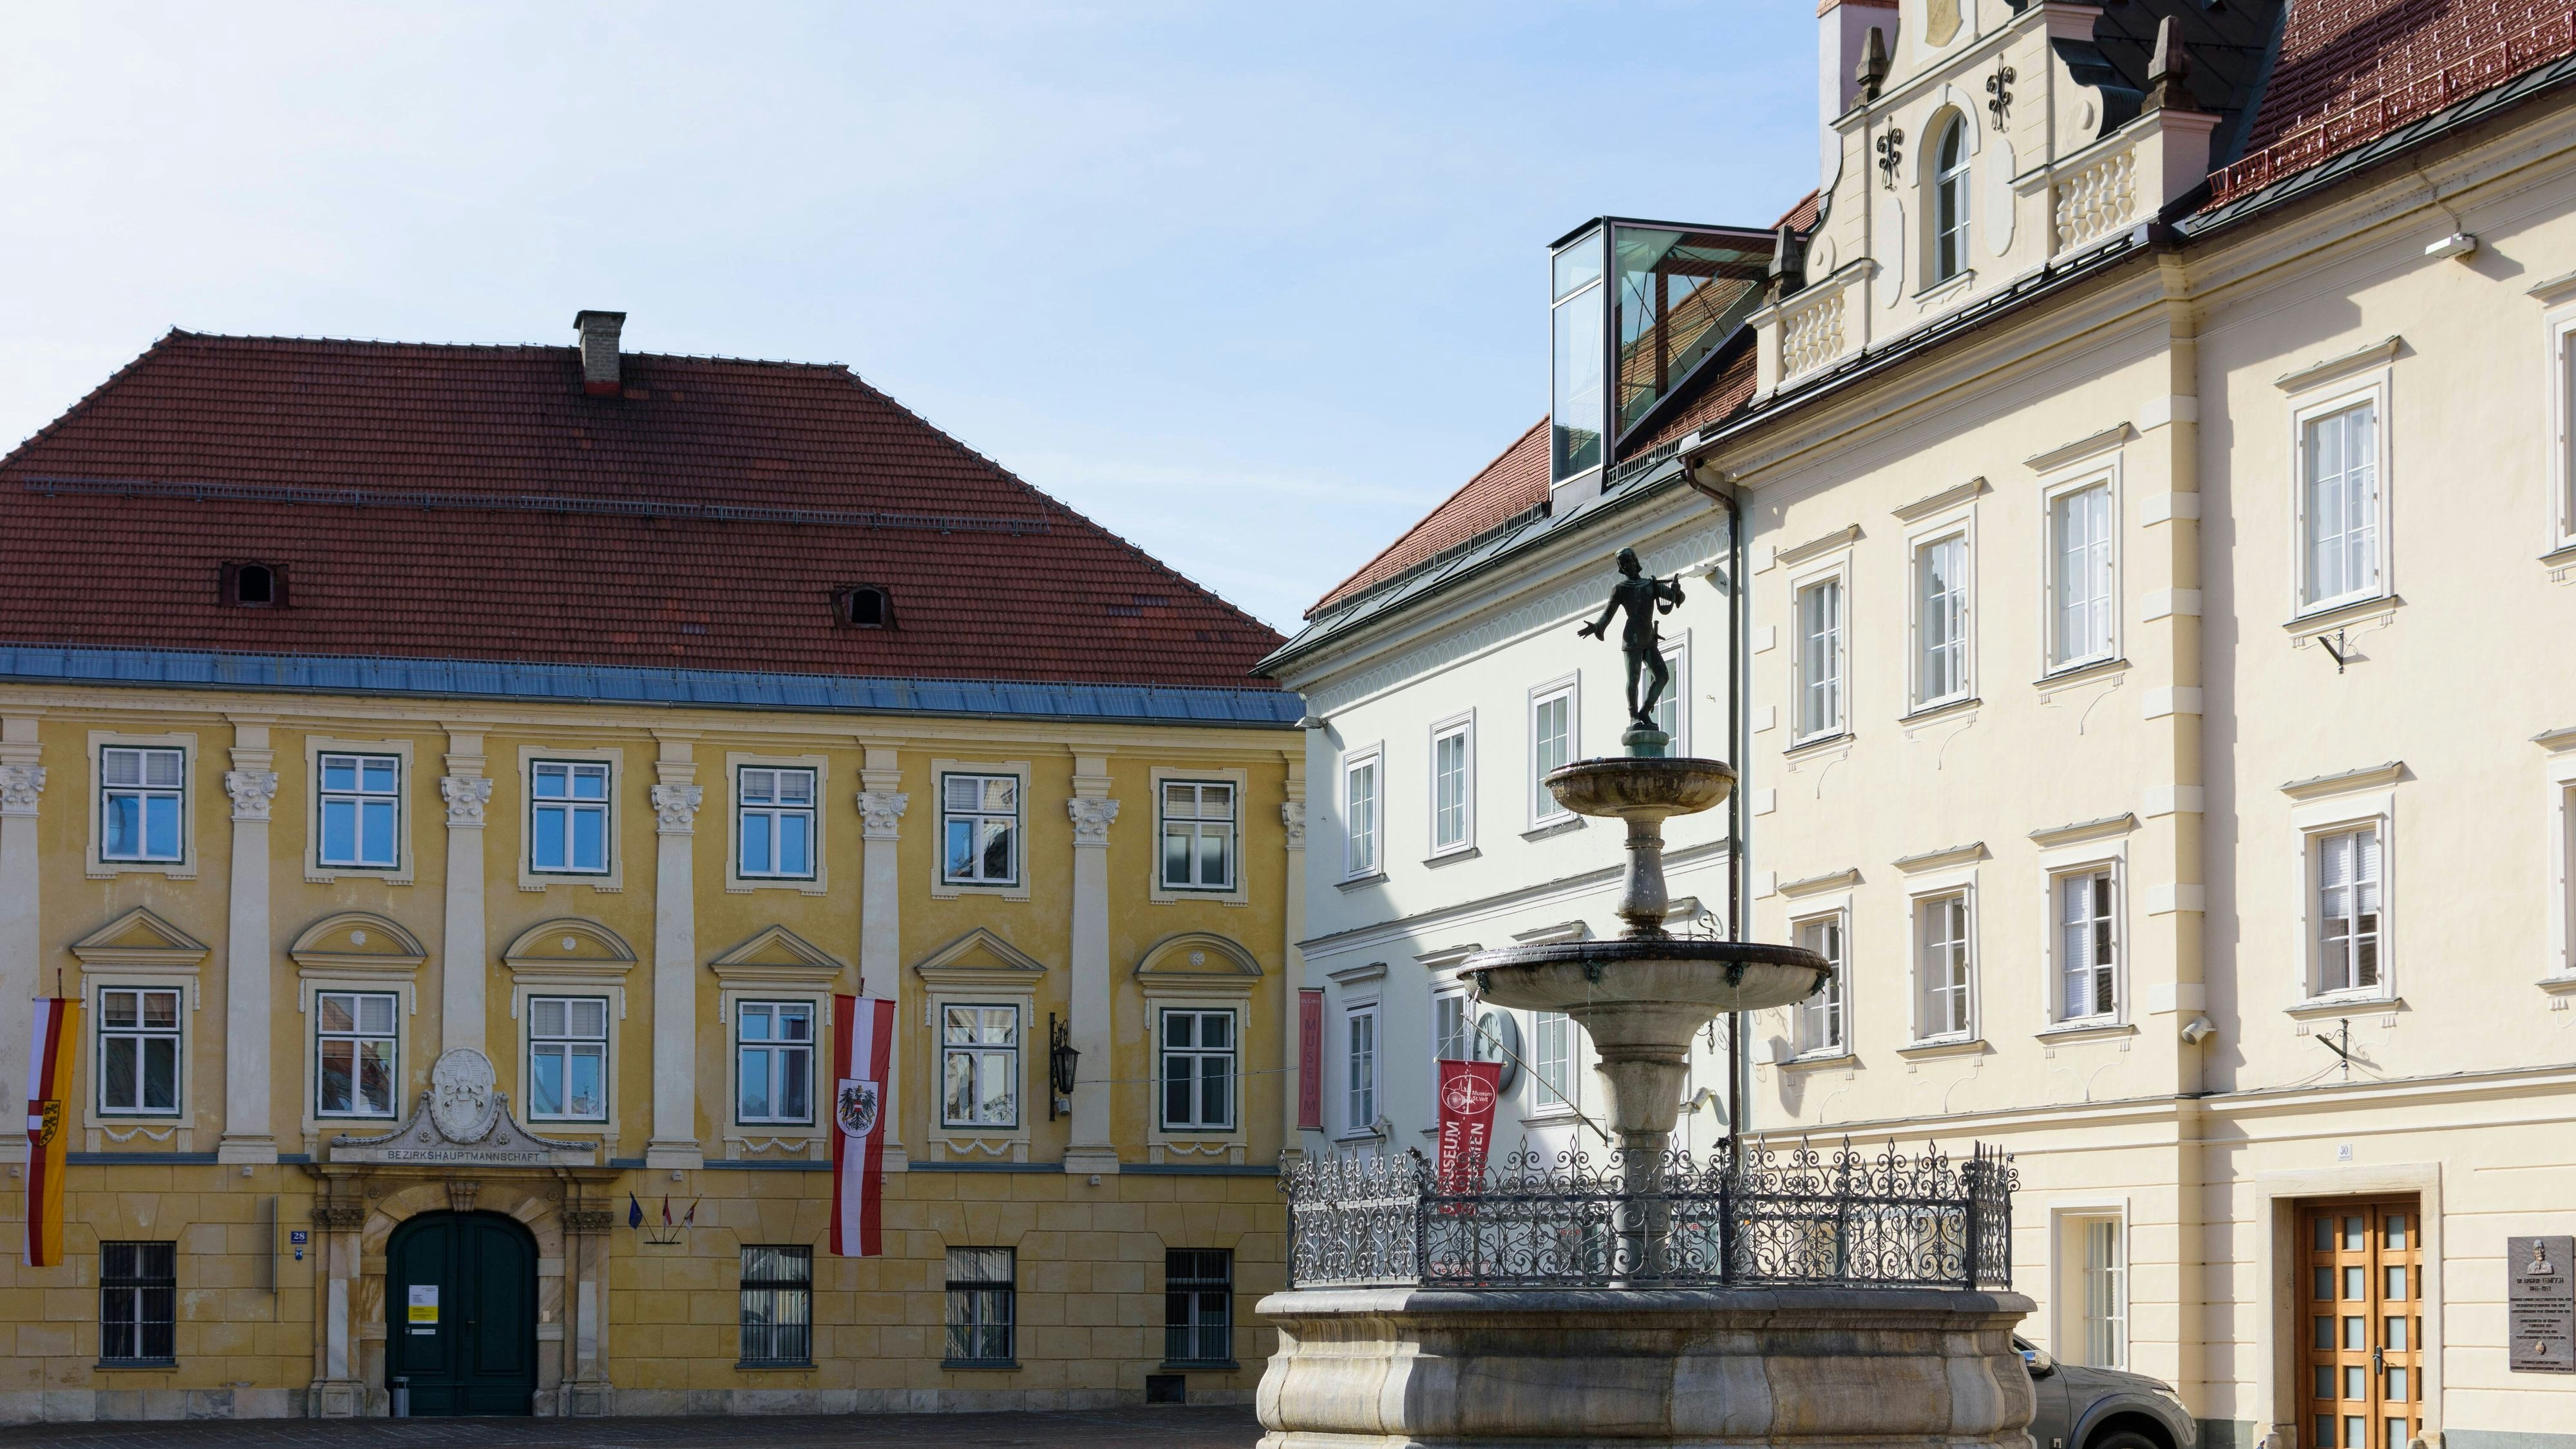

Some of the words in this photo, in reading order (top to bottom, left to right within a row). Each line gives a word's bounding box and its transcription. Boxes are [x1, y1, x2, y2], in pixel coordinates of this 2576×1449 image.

[1304, 1019, 1316, 1111] MUSEUM
[2340, 1146, 2349, 1155] 30
[388, 1150, 540, 1162] BEZIRKSHAUPTMANNSCHAFT
[293, 1232, 305, 1240] 28
